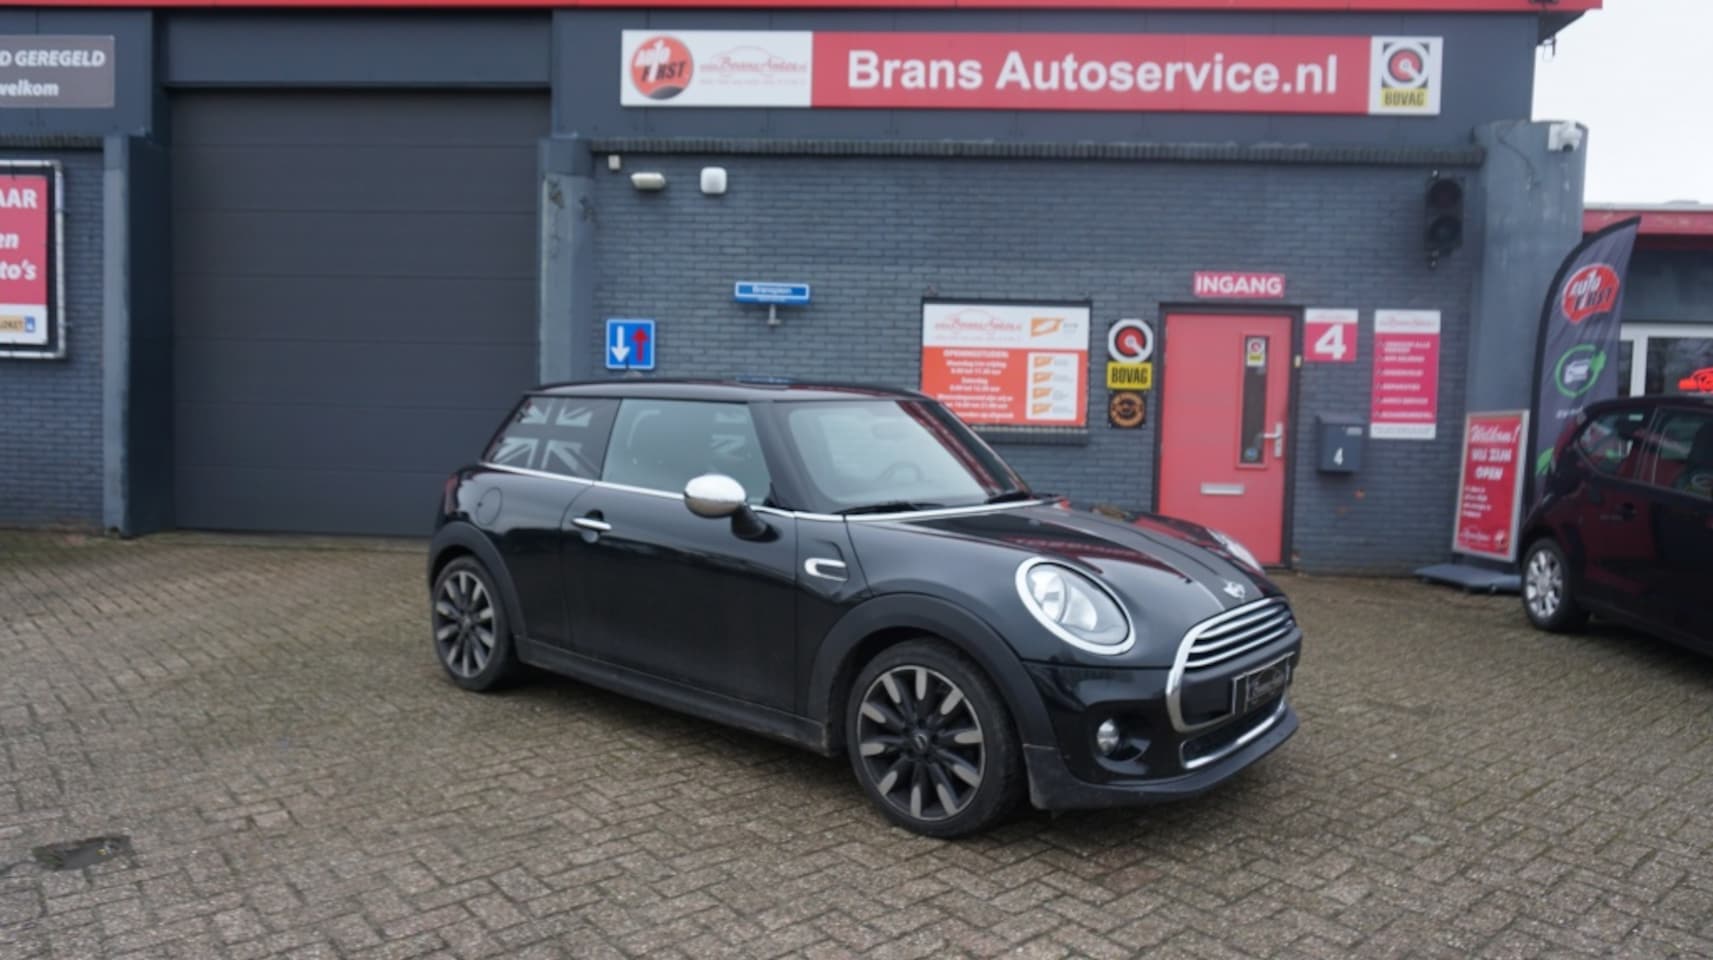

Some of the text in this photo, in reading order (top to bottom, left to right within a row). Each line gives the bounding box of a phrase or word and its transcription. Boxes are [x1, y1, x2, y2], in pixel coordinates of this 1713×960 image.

[15, 50, 106, 67] GEREGELD
[848, 50, 1338, 94] Brans Autoservice.nl
[1384, 90, 1425, 105] BOVAG
[1195, 275, 1283, 295] INGANG
[1315, 324, 1347, 360] 4
[1111, 367, 1149, 384] BOVAG
[1334, 447, 1343, 466] 4
[1476, 466, 1504, 480] OPEN
